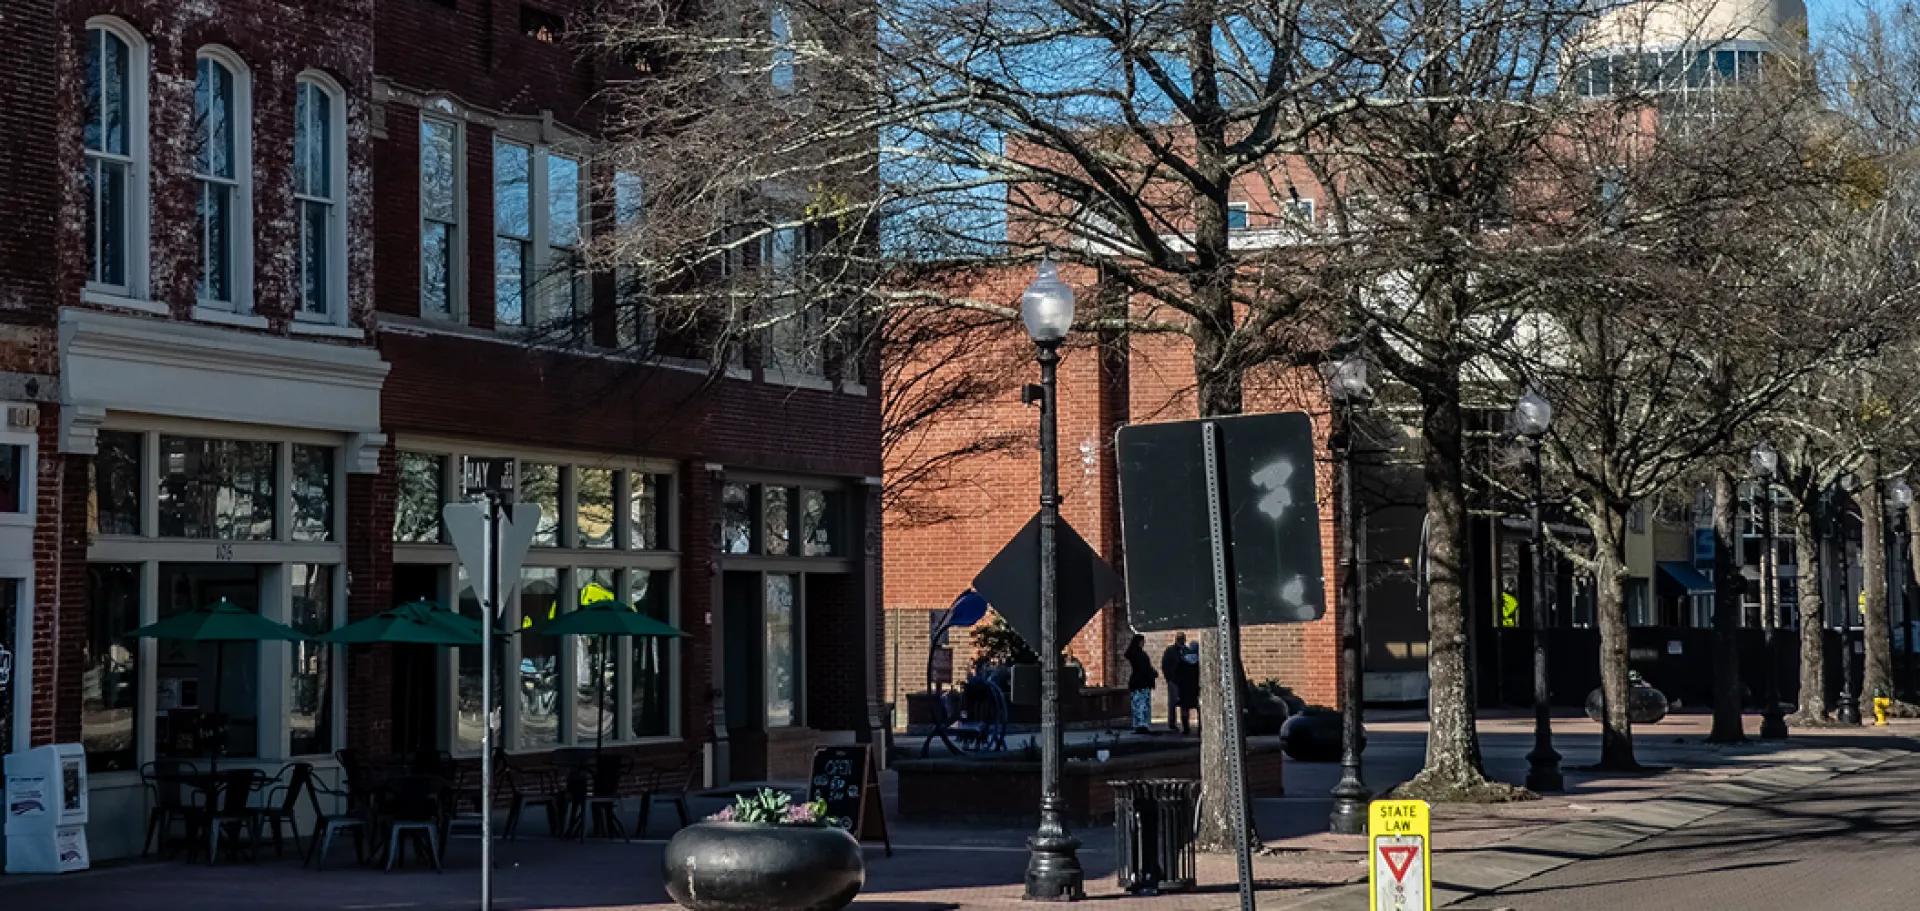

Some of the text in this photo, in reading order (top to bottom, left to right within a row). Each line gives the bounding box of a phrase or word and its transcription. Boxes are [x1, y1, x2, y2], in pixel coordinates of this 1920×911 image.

[466, 461, 490, 488] HAY
[1380, 805, 1417, 818] STATE
[1385, 820, 1411, 832] LAW
